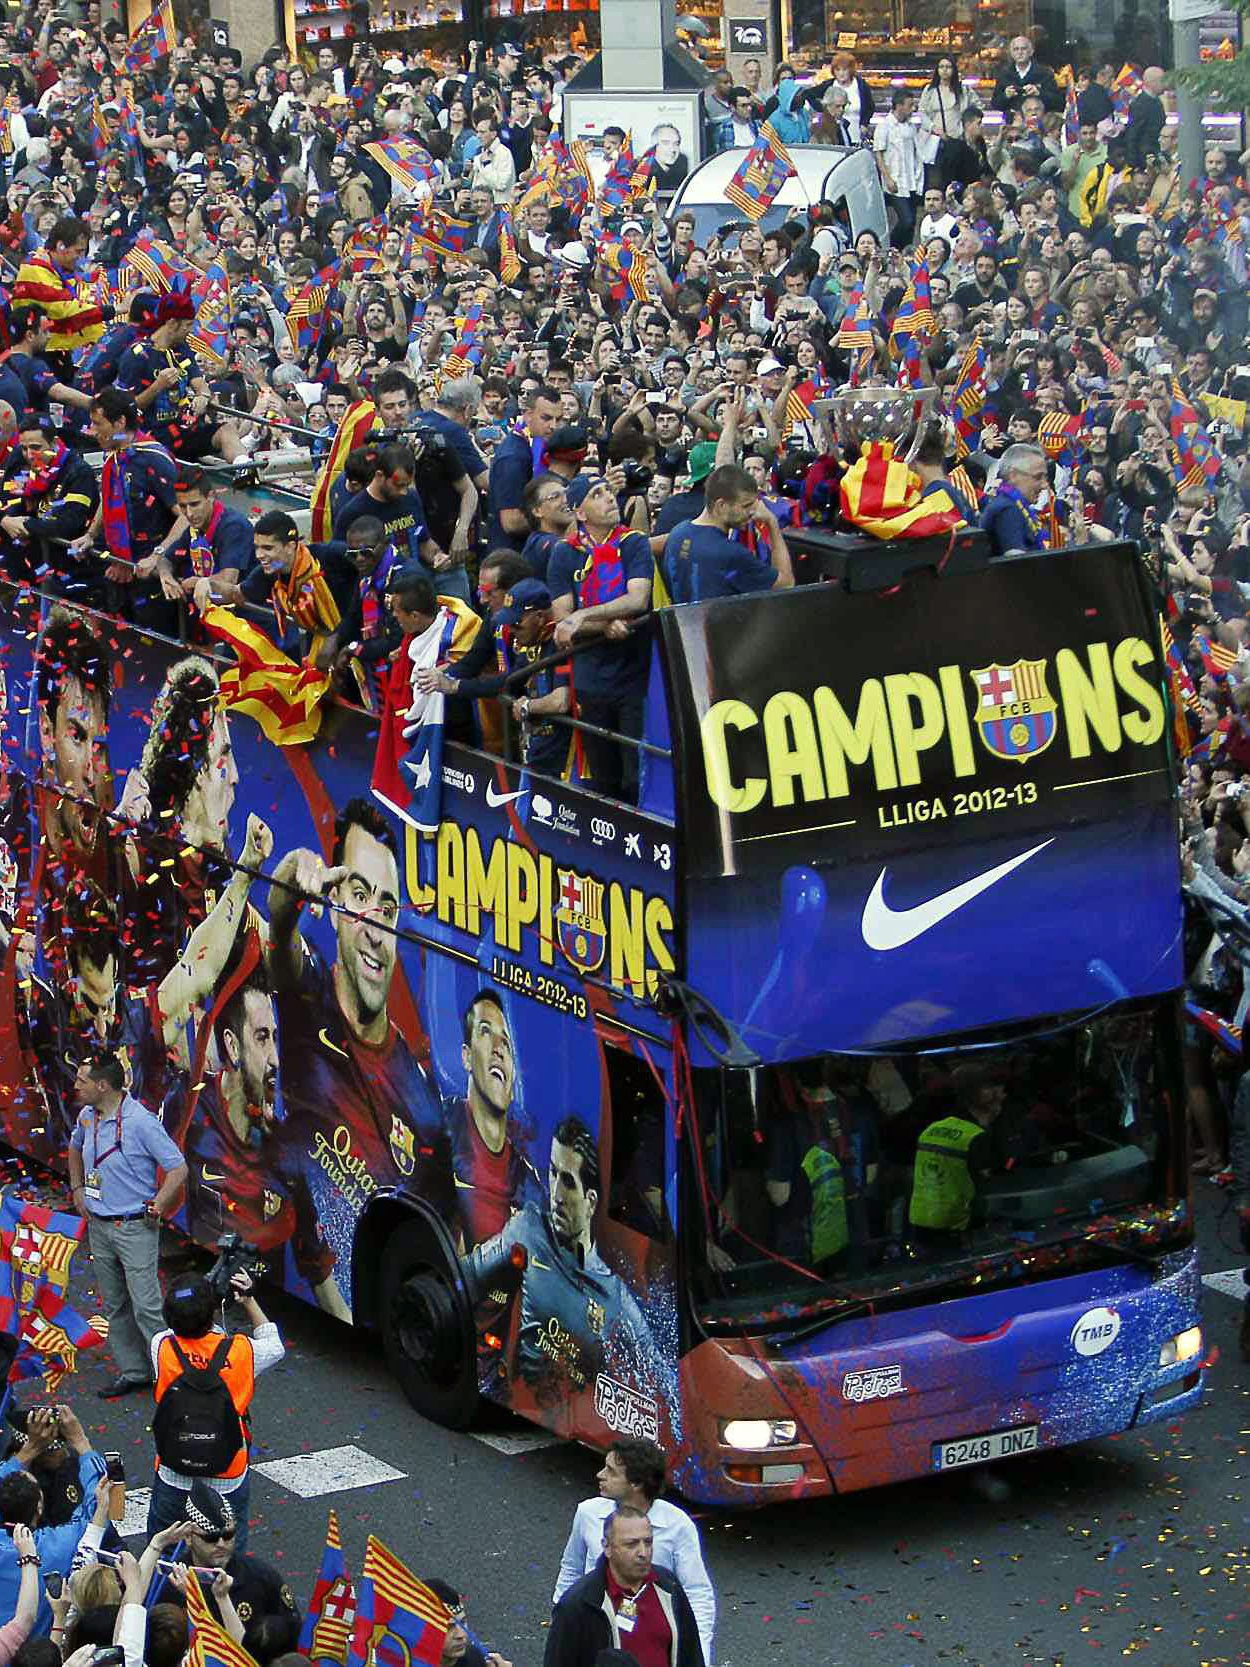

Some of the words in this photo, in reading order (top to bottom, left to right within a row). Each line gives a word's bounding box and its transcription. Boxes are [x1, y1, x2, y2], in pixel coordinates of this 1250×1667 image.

[999, 701, 1032, 717] FCB
[878, 799, 948, 828] LLIGA
[953, 783, 1038, 815] 2012-13
[570, 912, 591, 931] FCB
[1080, 1323, 1114, 1343] TMB
[944, 1440, 991, 1465] 6248
[1000, 1429, 1035, 1455] DNZ
